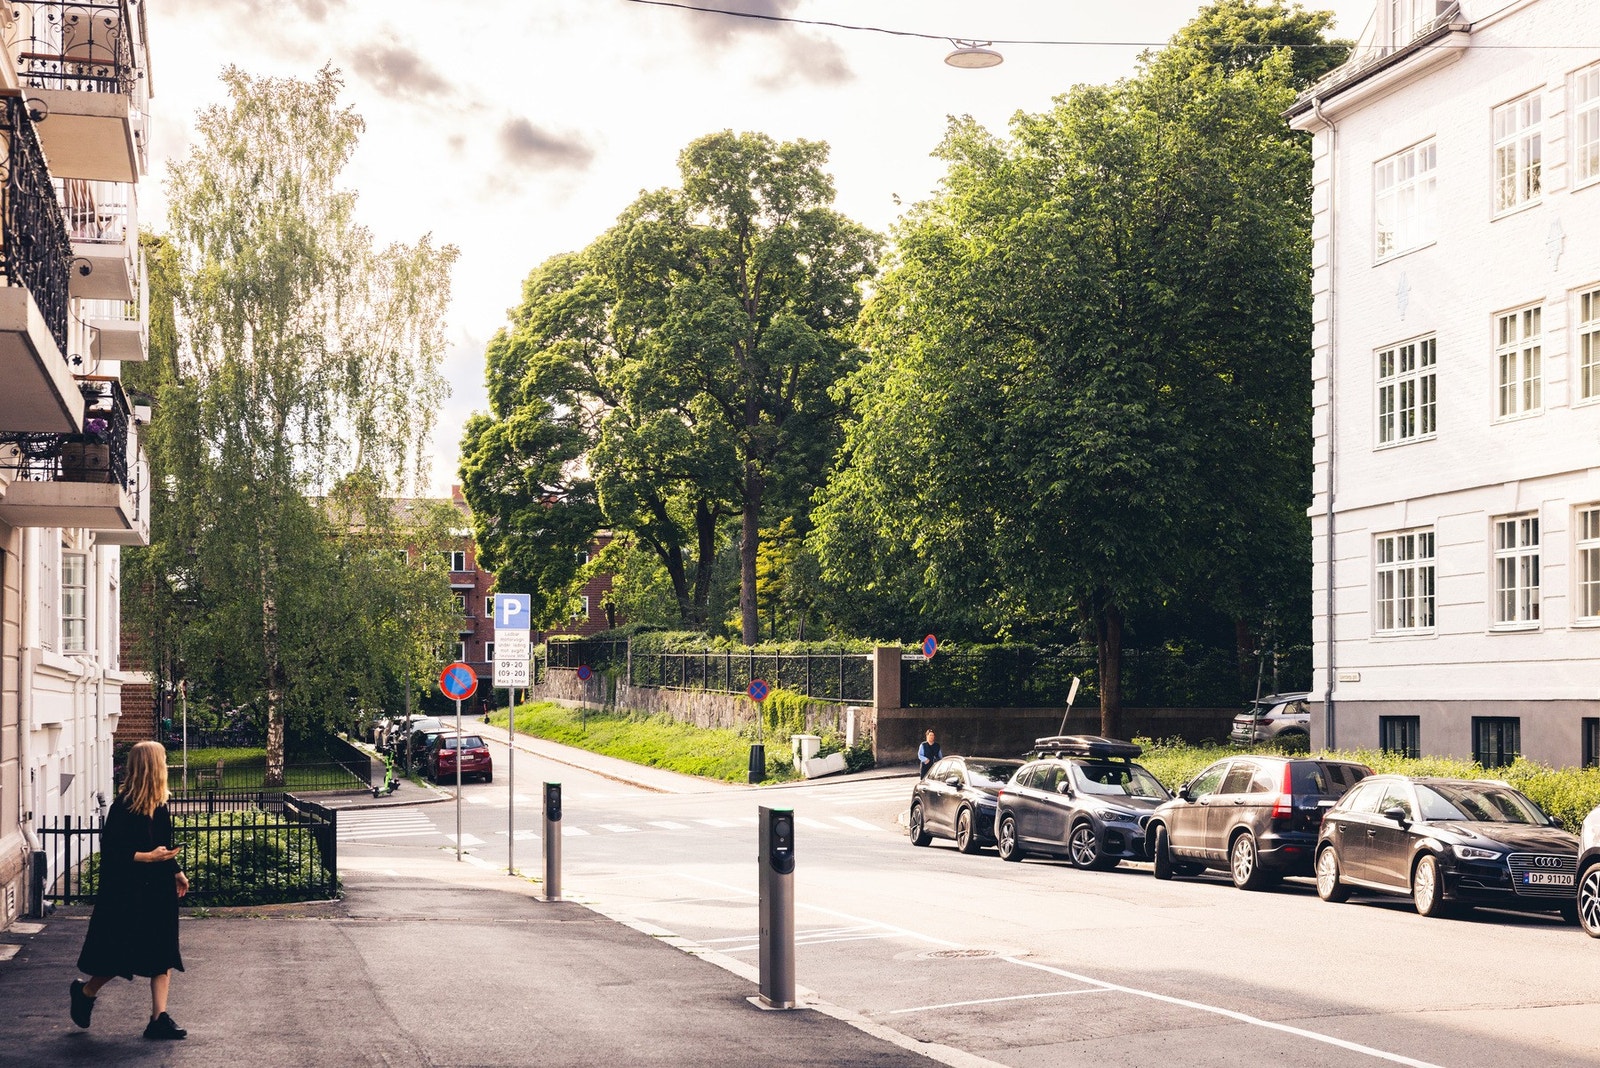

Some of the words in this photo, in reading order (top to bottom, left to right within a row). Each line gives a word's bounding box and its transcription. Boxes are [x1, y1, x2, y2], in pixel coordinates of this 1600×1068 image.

[503, 598, 521, 625] P
[1532, 873, 1544, 883] DP
[1547, 874, 1572, 884] 91120
